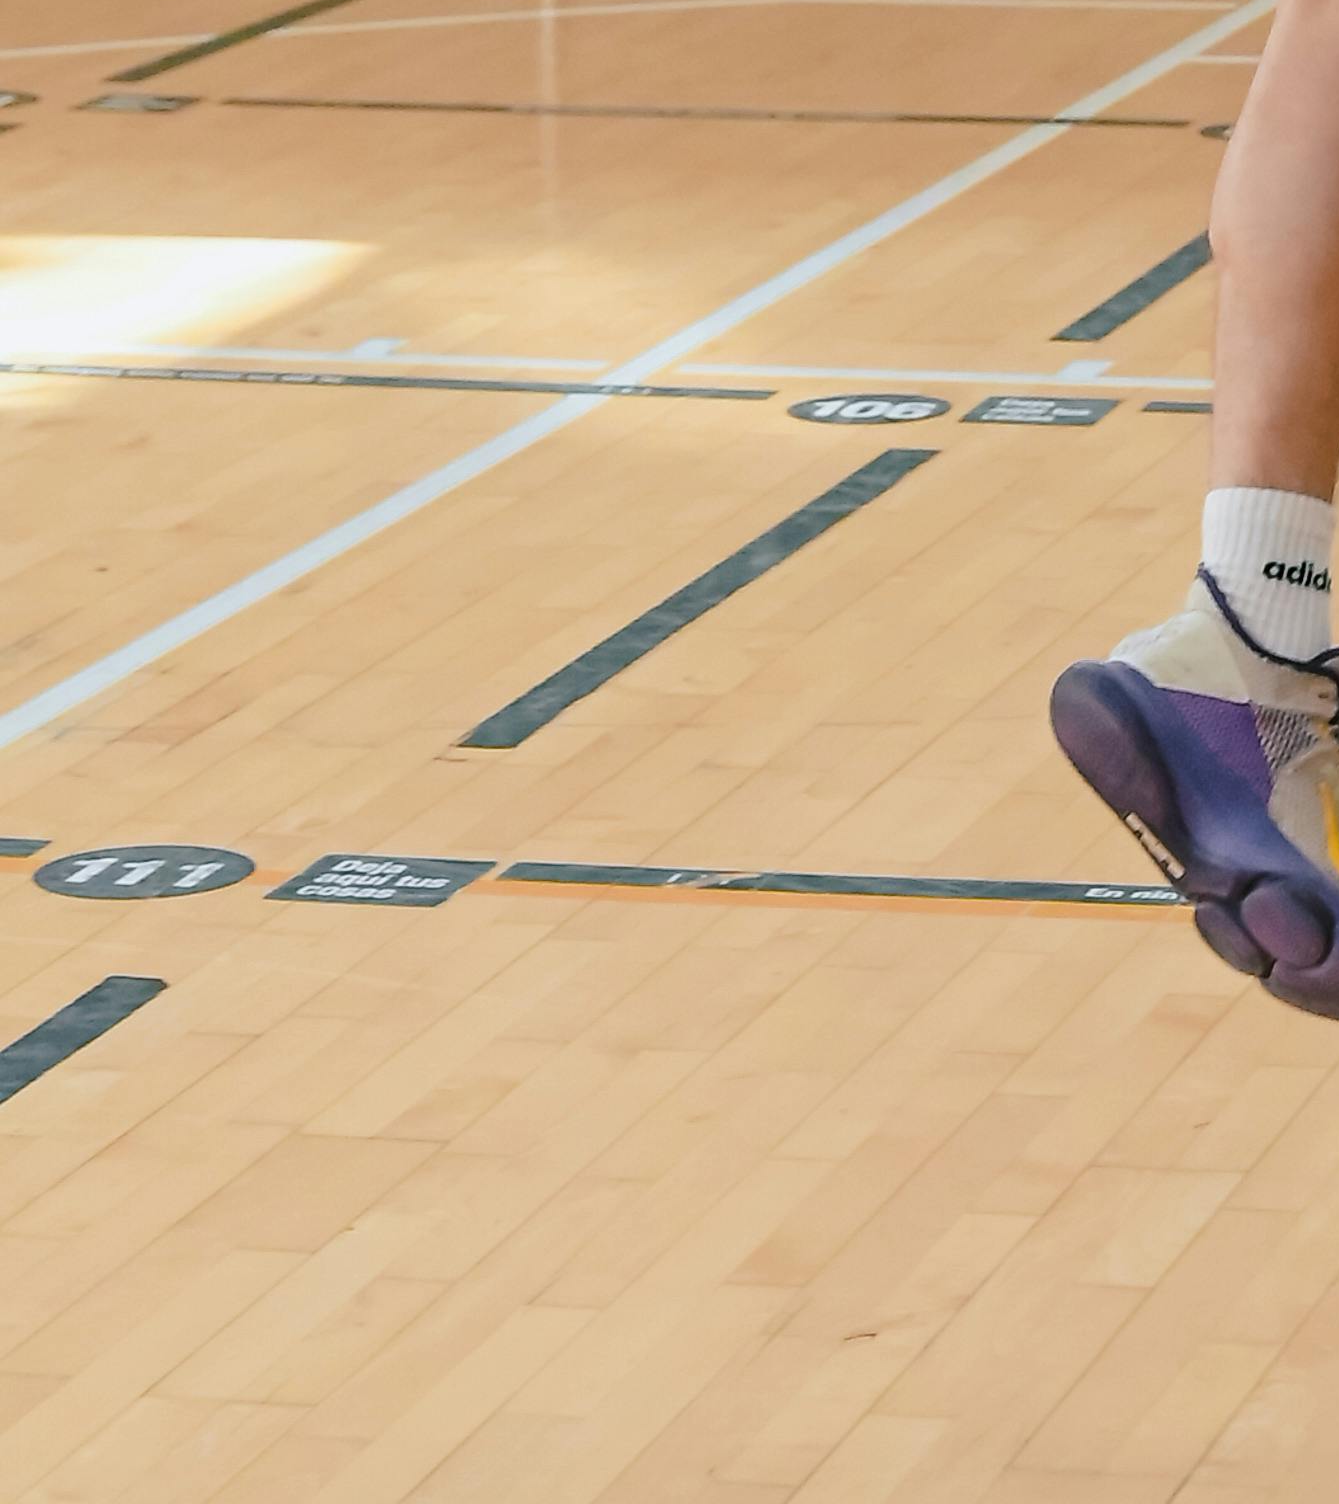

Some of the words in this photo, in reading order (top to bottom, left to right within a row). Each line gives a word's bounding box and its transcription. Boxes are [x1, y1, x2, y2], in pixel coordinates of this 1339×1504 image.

[812, 398, 937, 421] 106
[1263, 560, 1332, 593] adid
[65, 857, 225, 888] 111
[331, 859, 409, 875] Deja
[393, 875, 451, 889] tus
[295, 885, 397, 899] cosas
[1084, 888, 1125, 898] En
[1130, 889, 1184, 901] nin
